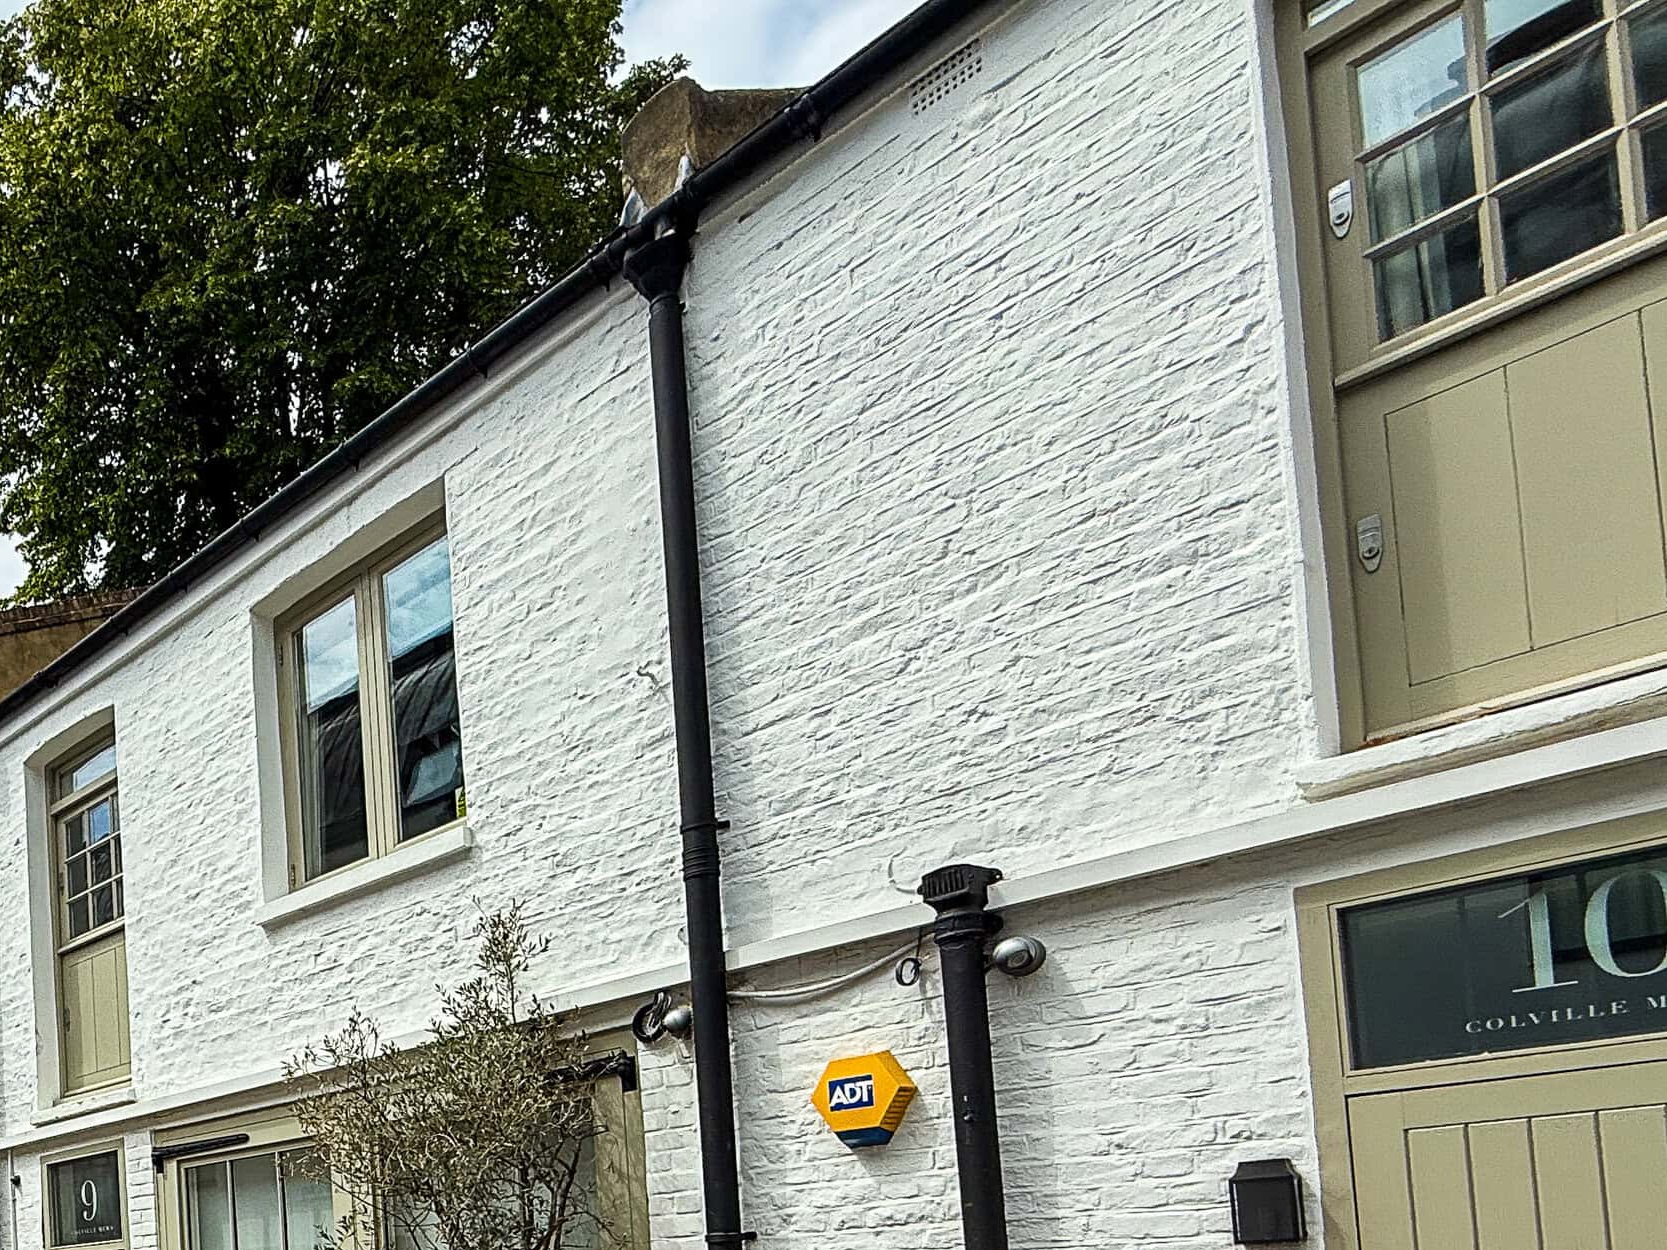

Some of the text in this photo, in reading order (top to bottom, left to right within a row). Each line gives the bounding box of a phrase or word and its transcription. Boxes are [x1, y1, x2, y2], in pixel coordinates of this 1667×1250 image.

[1497, 870, 1667, 993] 10
[1465, 1000, 1631, 1034] COLVILLE
[829, 1080, 873, 1107] ADT
[80, 1179, 98, 1221] 9
